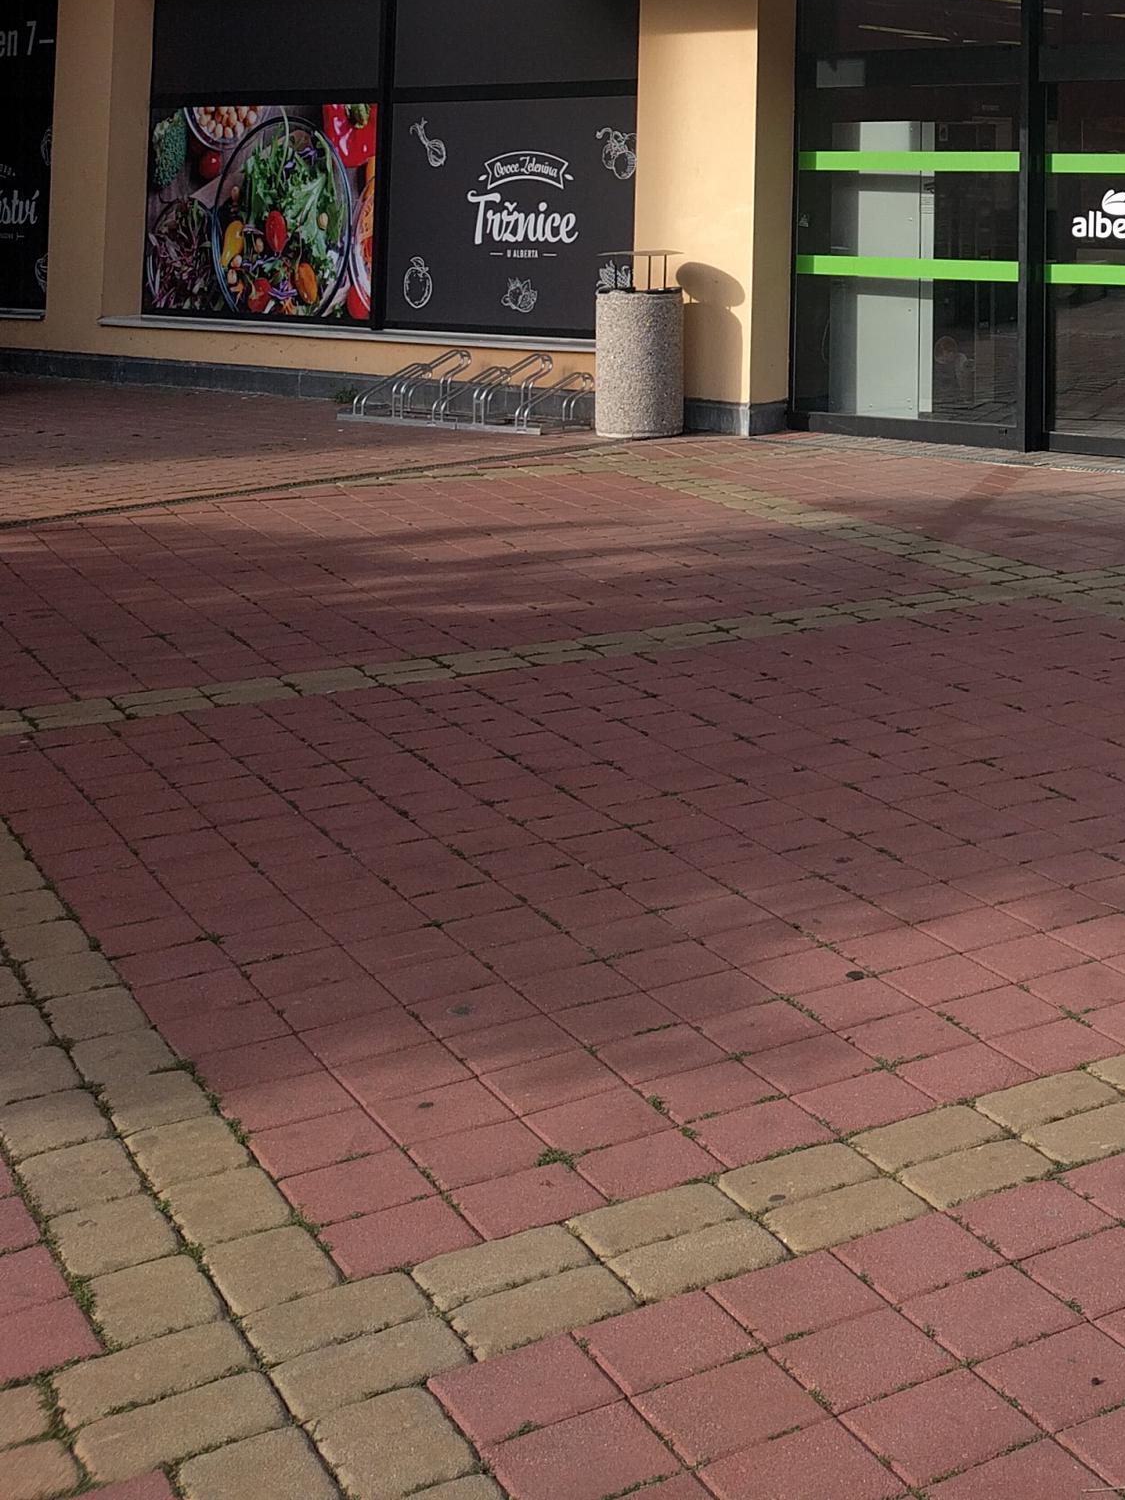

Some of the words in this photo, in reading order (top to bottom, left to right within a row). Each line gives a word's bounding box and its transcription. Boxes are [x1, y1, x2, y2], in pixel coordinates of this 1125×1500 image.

[494, 161, 520, 178] Ovoce
[520, 156, 559, 178] Zelenina
[467, 190, 579, 245] Tržnice
[506, 249, 512, 258] U
[513, 249, 539, 258] ALBERTA
